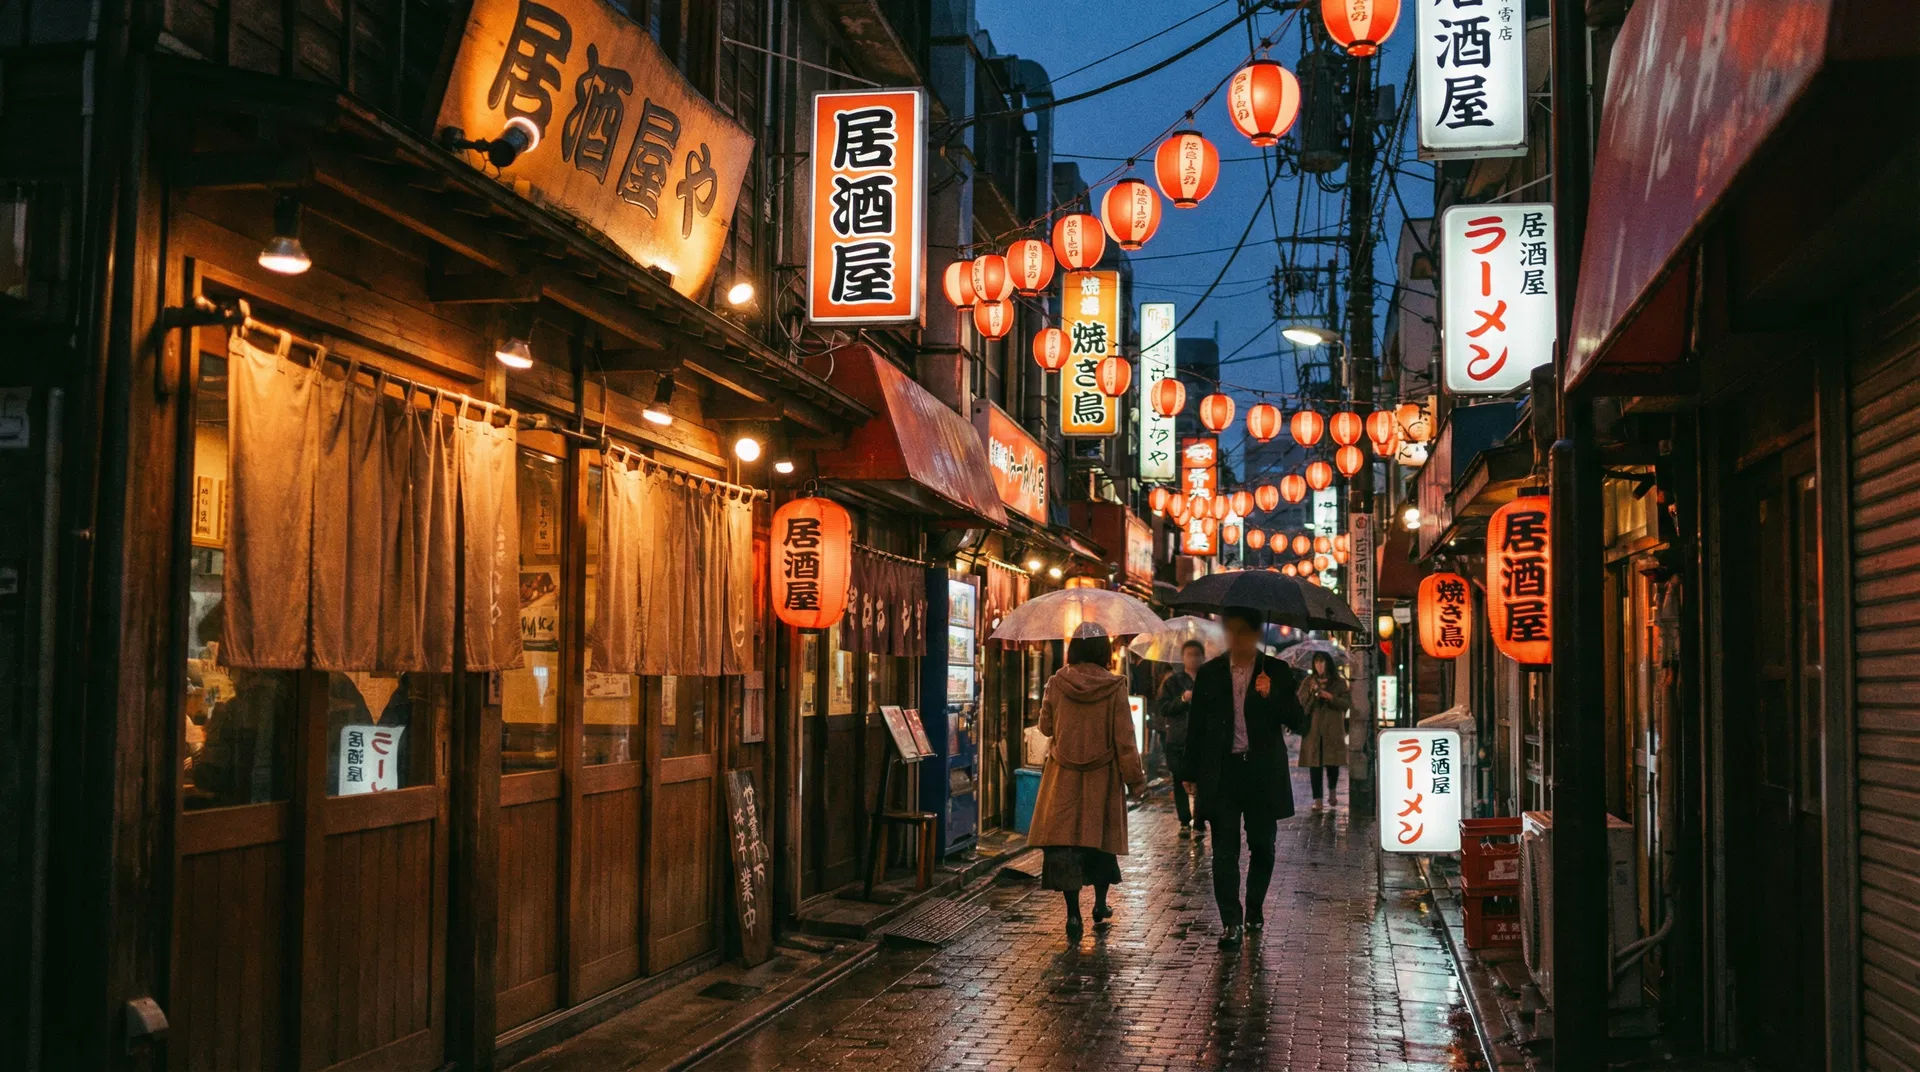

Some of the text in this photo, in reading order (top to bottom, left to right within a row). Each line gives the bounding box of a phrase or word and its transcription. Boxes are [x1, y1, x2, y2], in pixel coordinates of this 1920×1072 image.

[1434, 0, 1495, 130] 酒屋
[487, 0, 718, 240] 居酒屋や
[831, 109, 895, 302] 居酒屋
[1519, 212, 1548, 295] 居酒屋
[1464, 216, 1508, 381] ラーメン
[1073, 322, 1107, 425] 焼き鳥
[783, 517, 821, 611] 居酒屋
[1437, 579, 1466, 648] 焼き鳥
[1501, 511, 1550, 642] 居酒屋
[1397, 738, 1423, 844] ラーメン
[1430, 738, 1451, 794] 居酒屋
